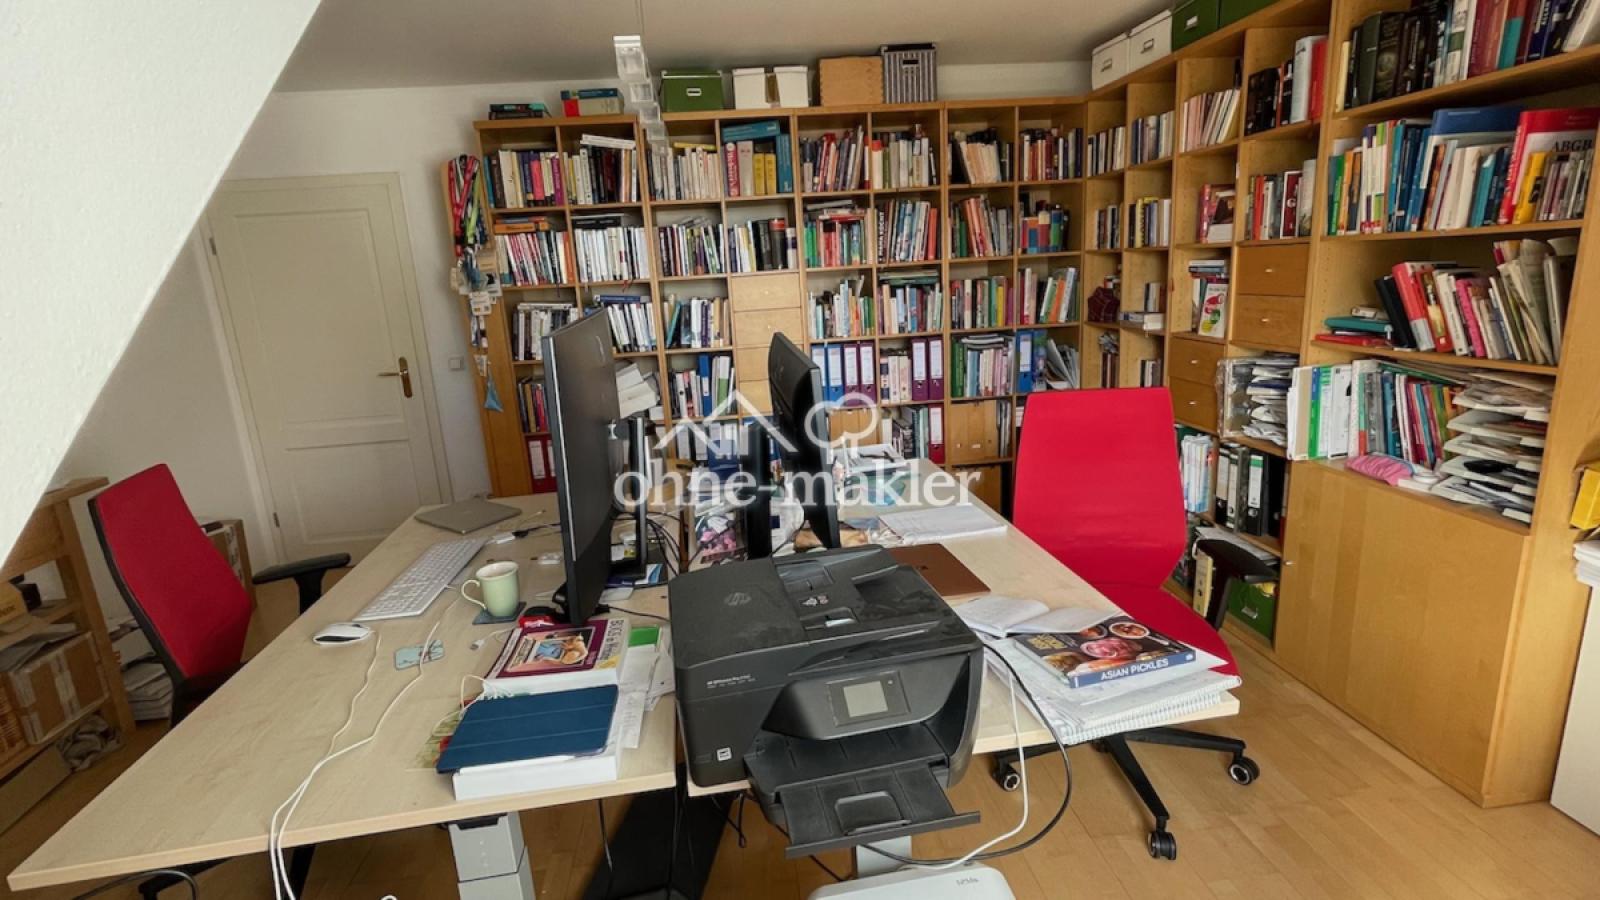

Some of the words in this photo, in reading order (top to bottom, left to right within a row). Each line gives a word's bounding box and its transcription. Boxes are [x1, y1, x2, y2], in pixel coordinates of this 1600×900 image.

[1551, 139, 1593, 152] ABGB
[1100, 666, 1129, 681] ASIAN
[1131, 658, 1169, 676] PICKLES
